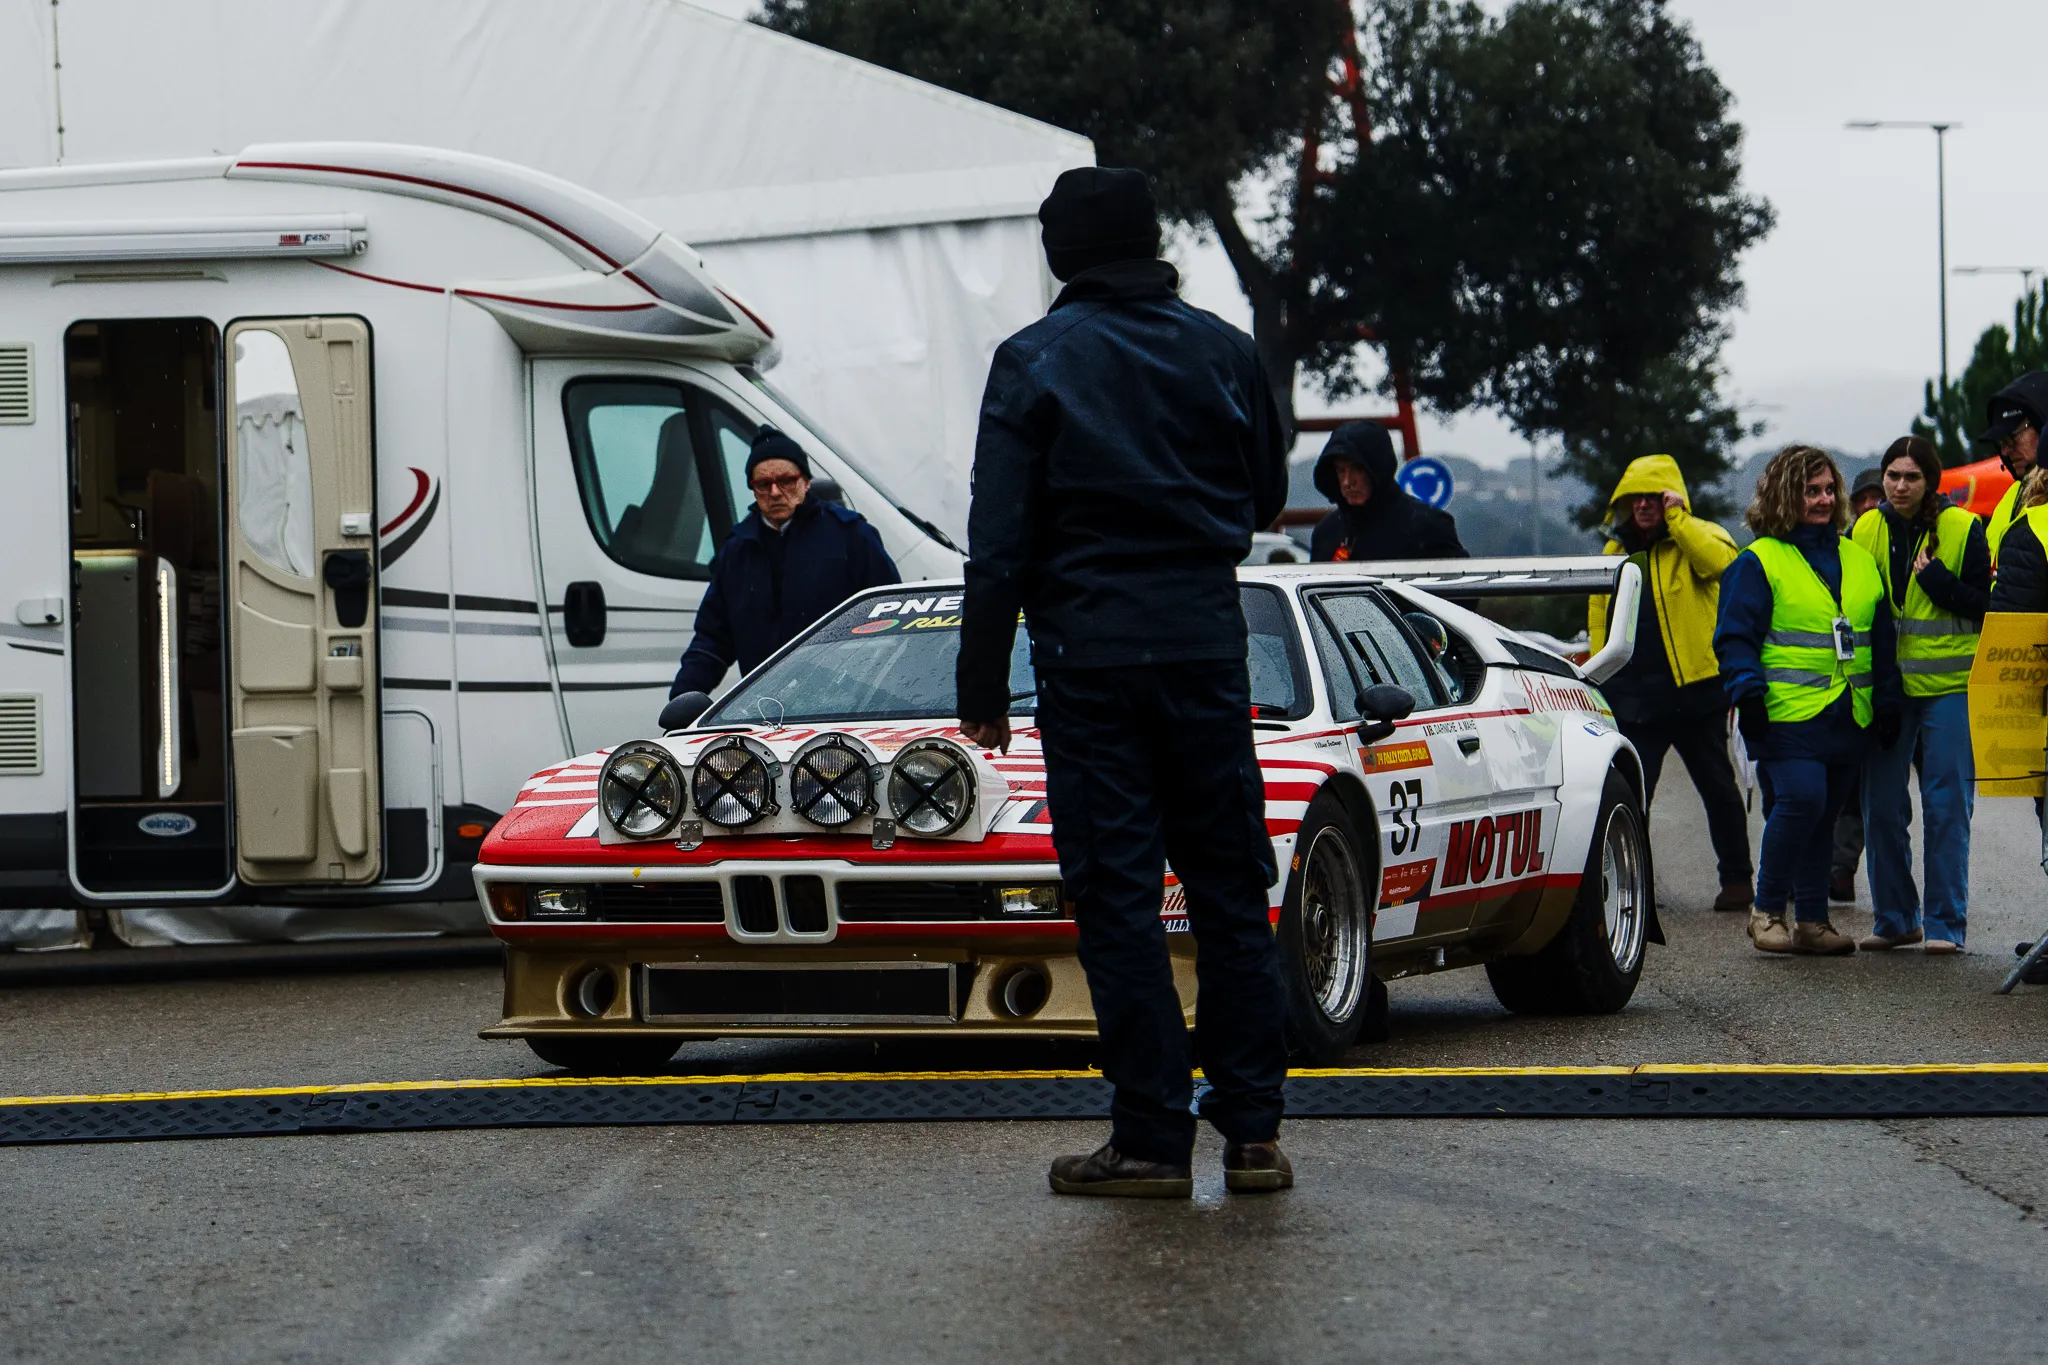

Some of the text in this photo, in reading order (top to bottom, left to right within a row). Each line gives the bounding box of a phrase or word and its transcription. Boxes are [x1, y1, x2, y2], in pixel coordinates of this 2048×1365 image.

[868, 595, 965, 618] PNE
[1389, 778, 1422, 856] 37
[1440, 808, 1545, 889] MOTUL
